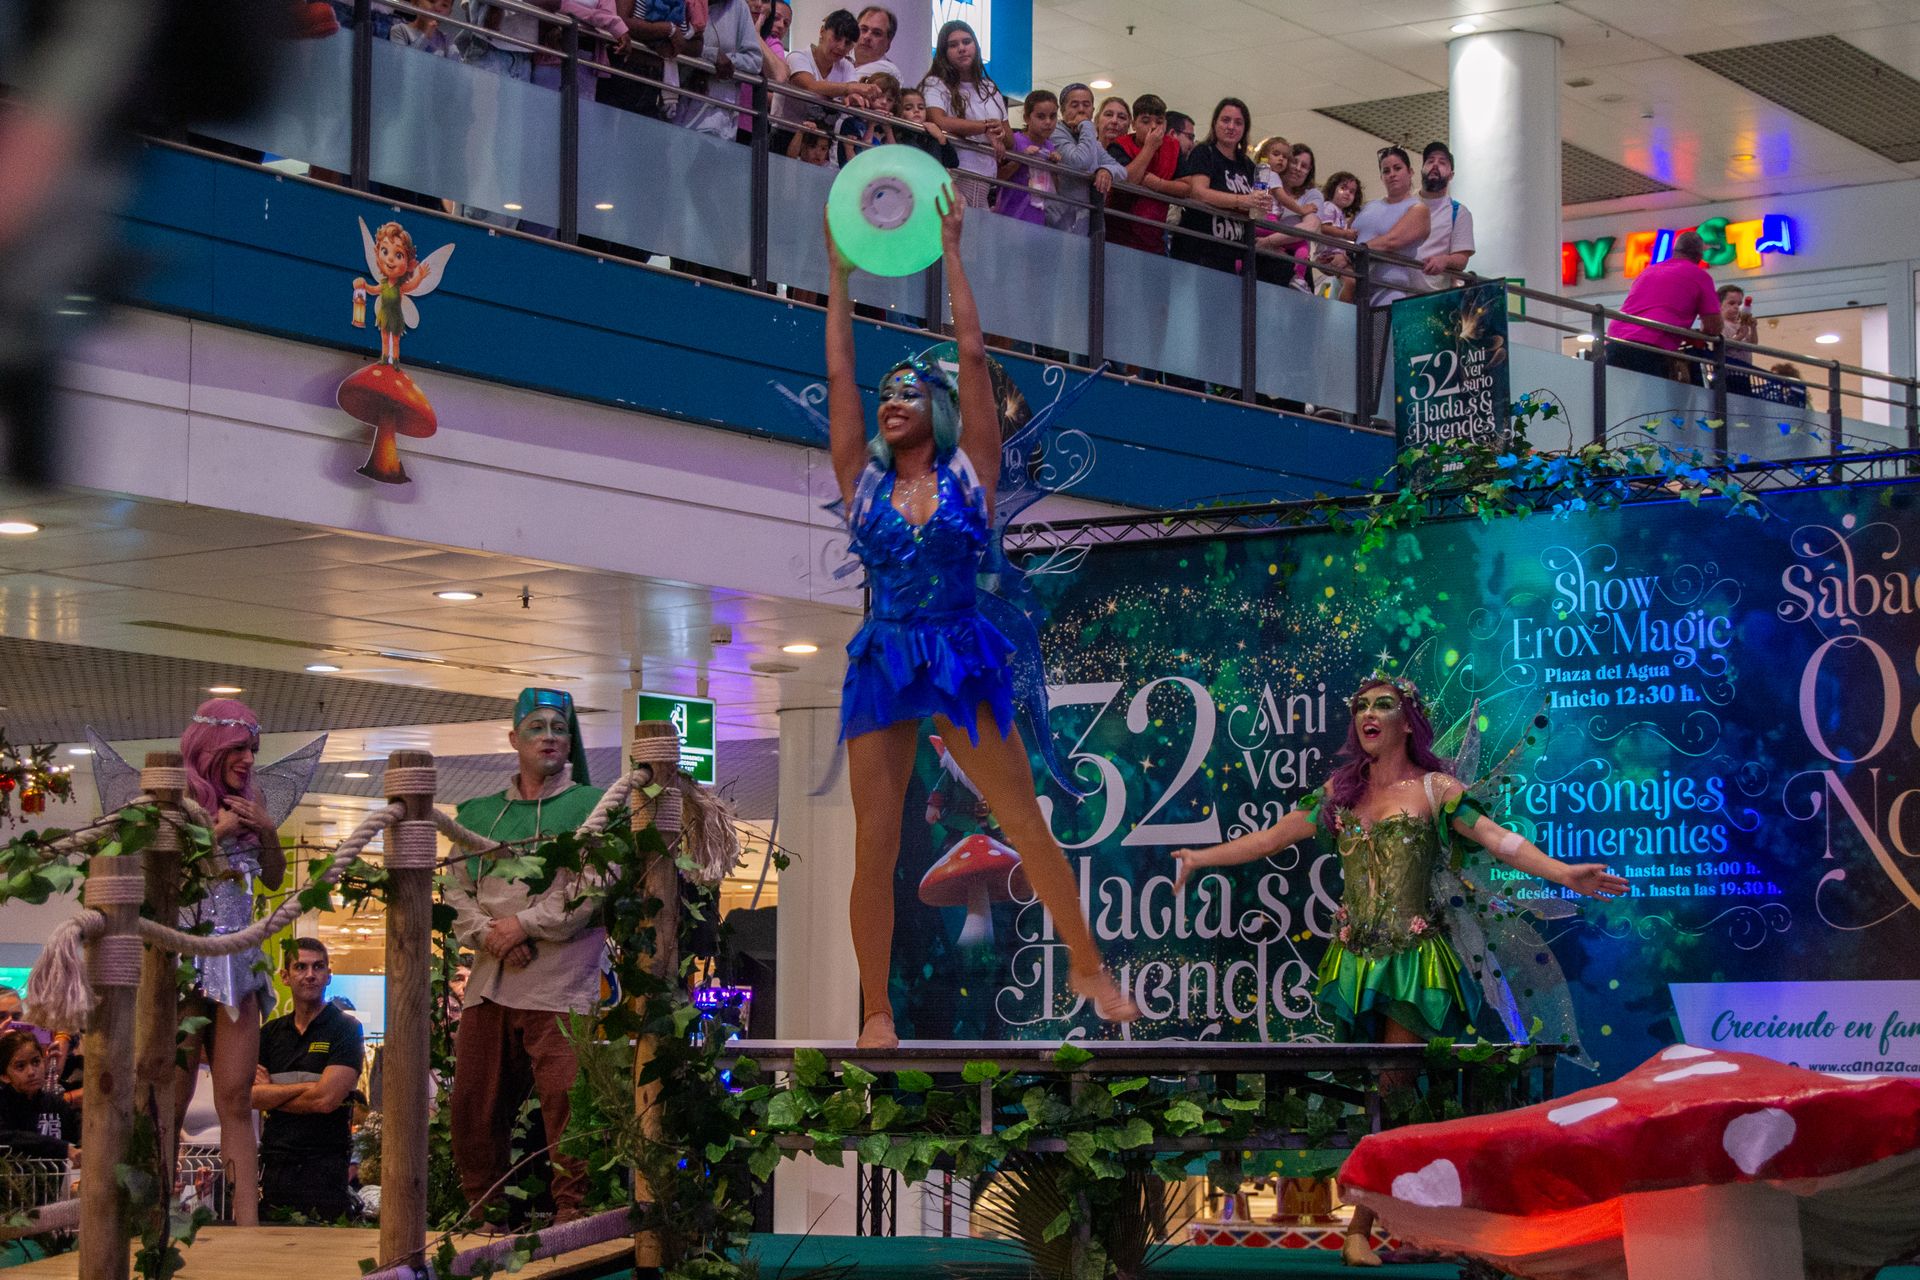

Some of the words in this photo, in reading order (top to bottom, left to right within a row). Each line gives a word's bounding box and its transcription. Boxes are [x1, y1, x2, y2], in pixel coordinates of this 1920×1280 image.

[1624, 214, 1796, 278] FISTA
[1410, 350, 1461, 400] 32
[1463, 346, 1486, 364] Ani
[1407, 395, 1478, 422] Hadas
[1405, 412, 1496, 446] Duendes
[1546, 545, 1660, 618] Show
[1778, 524, 1920, 624] Sába
[1513, 617, 1600, 660] Erox
[1613, 610, 1732, 670] Magic
[1545, 667, 1591, 683] Plaza
[1596, 664, 1622, 681] del
[1626, 662, 1670, 681] Agua
[1230, 683, 1326, 746] Ani
[1550, 689, 1610, 708] Inicio
[1616, 684, 1675, 705] 12:30
[1680, 685, 1701, 703] h.
[1036, 676, 1223, 849] 32
[1242, 746, 1320, 790] ver
[1500, 769, 1726, 820] Personajes
[1540, 820, 1729, 857] Itinerantes
[1625, 864, 1666, 878] hasta
[1669, 863, 1691, 877] las
[1696, 861, 1740, 876] 13:00
[1745, 861, 1761, 875] h.
[1516, 886, 1557, 900] desde
[1631, 884, 1646, 897] h.
[1650, 882, 1690, 897] hasta
[1694, 881, 1716, 896] las
[1720, 881, 1763, 896] 19:30
[1767, 881, 1783, 895] h.
[1711, 1010, 1839, 1042] Creciendo
[1844, 1020, 1876, 1039] en
